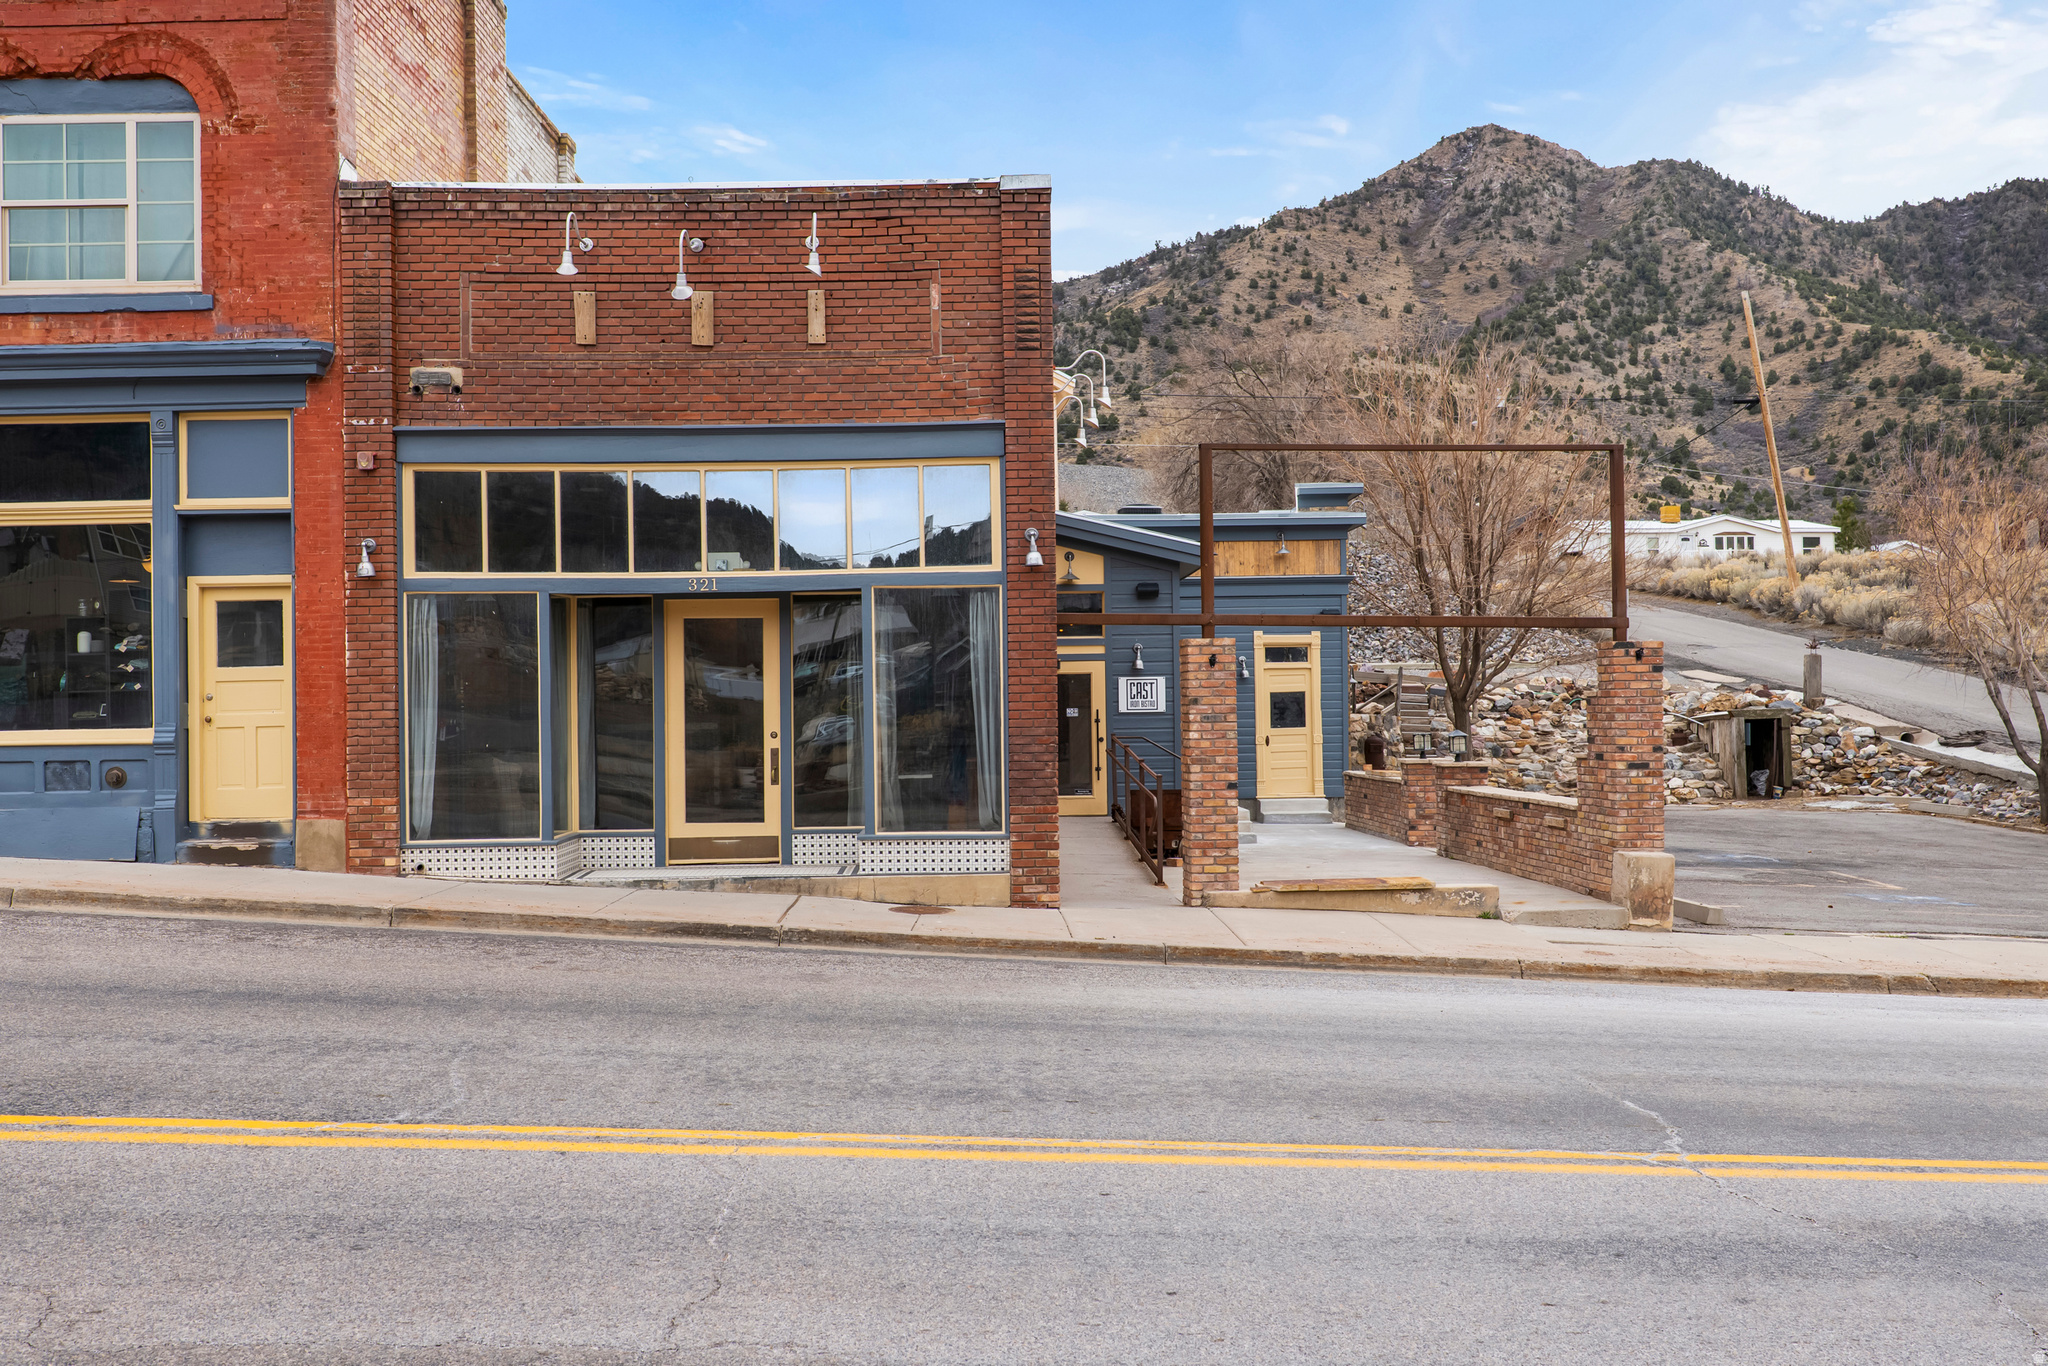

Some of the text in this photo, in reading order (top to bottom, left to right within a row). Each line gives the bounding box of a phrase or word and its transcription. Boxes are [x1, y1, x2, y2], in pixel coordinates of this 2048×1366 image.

[688, 578, 718, 591] 321
[1129, 682, 1155, 699] CAST
[1141, 700, 1155, 708] BISTRO
